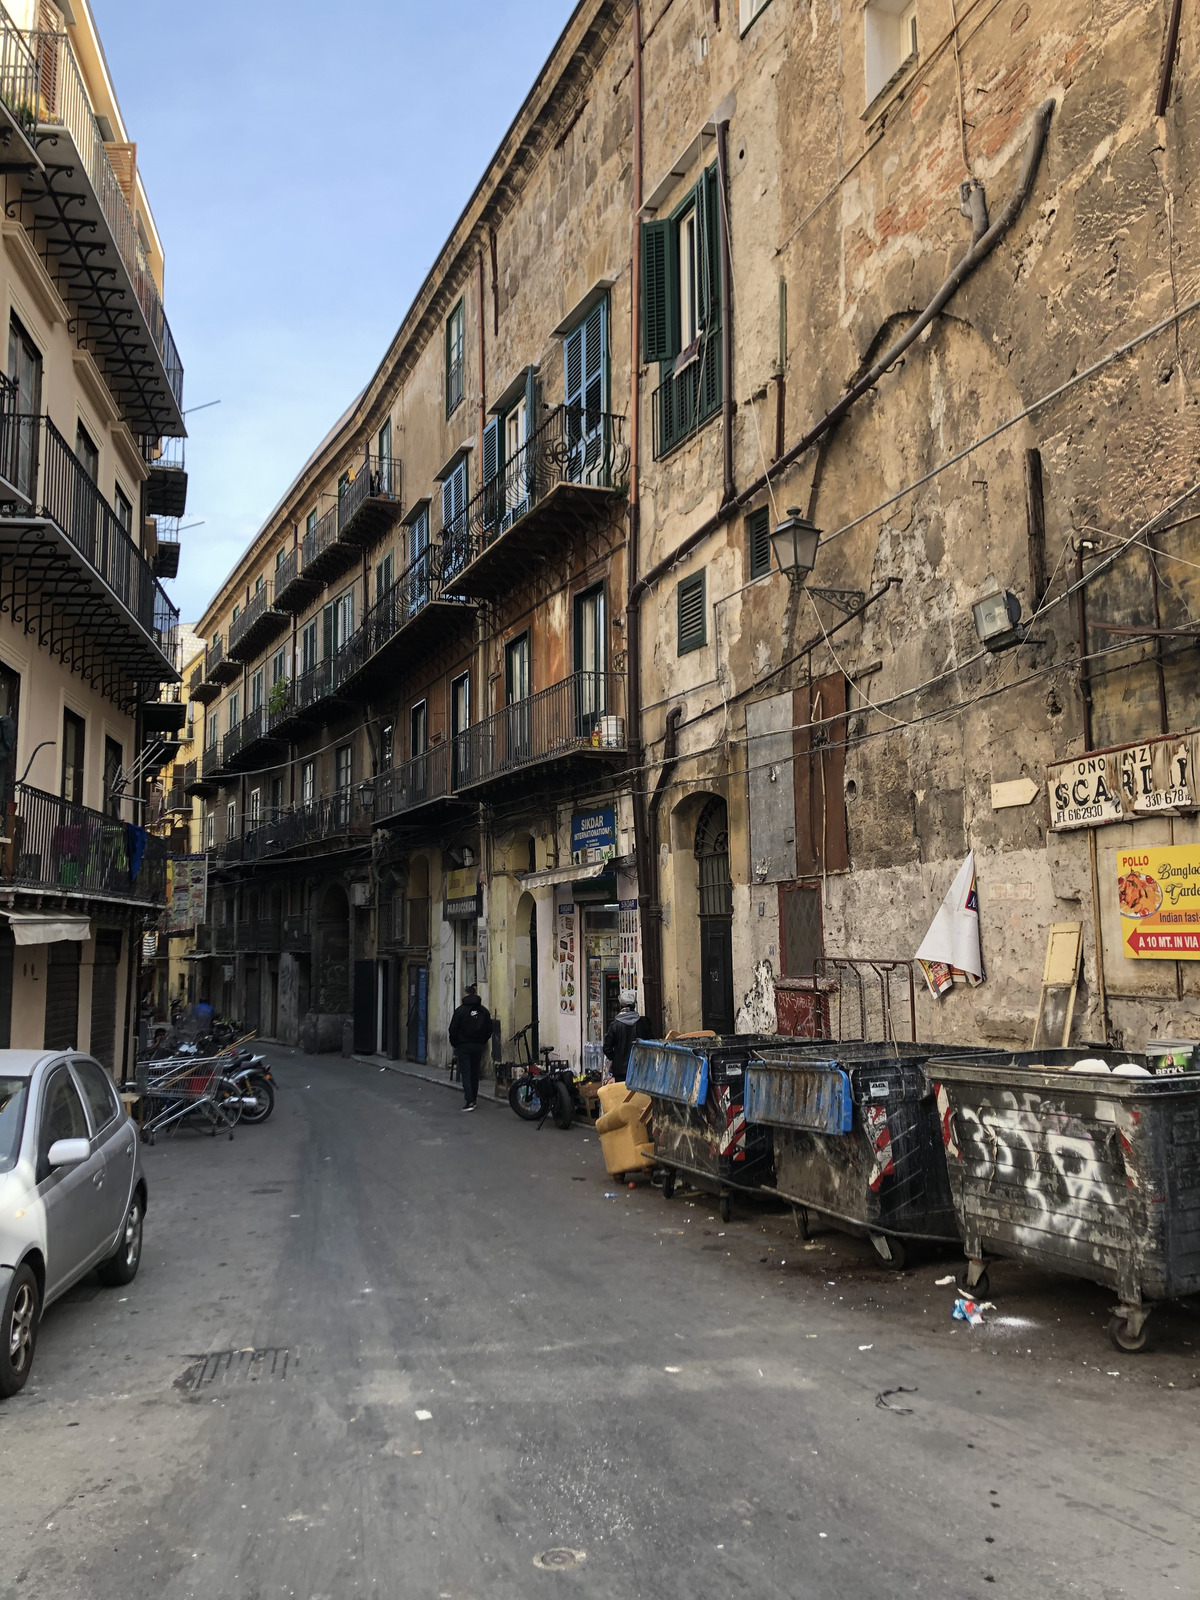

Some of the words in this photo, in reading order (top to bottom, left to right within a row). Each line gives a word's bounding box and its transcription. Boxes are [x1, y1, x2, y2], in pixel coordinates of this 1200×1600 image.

[1068, 804, 1103, 821] 6162930
[581, 815, 604, 831] SIKDAR
[1122, 855, 1149, 867] POLLO
[1159, 912, 1180, 923] Indian
[1139, 936, 1145, 948] A
[1147, 936, 1157, 948] 10
[1174, 936, 1183, 948] IN
[1184, 936, 1199, 948] VIA
[1155, 1066, 1184, 1075] BECK'S
